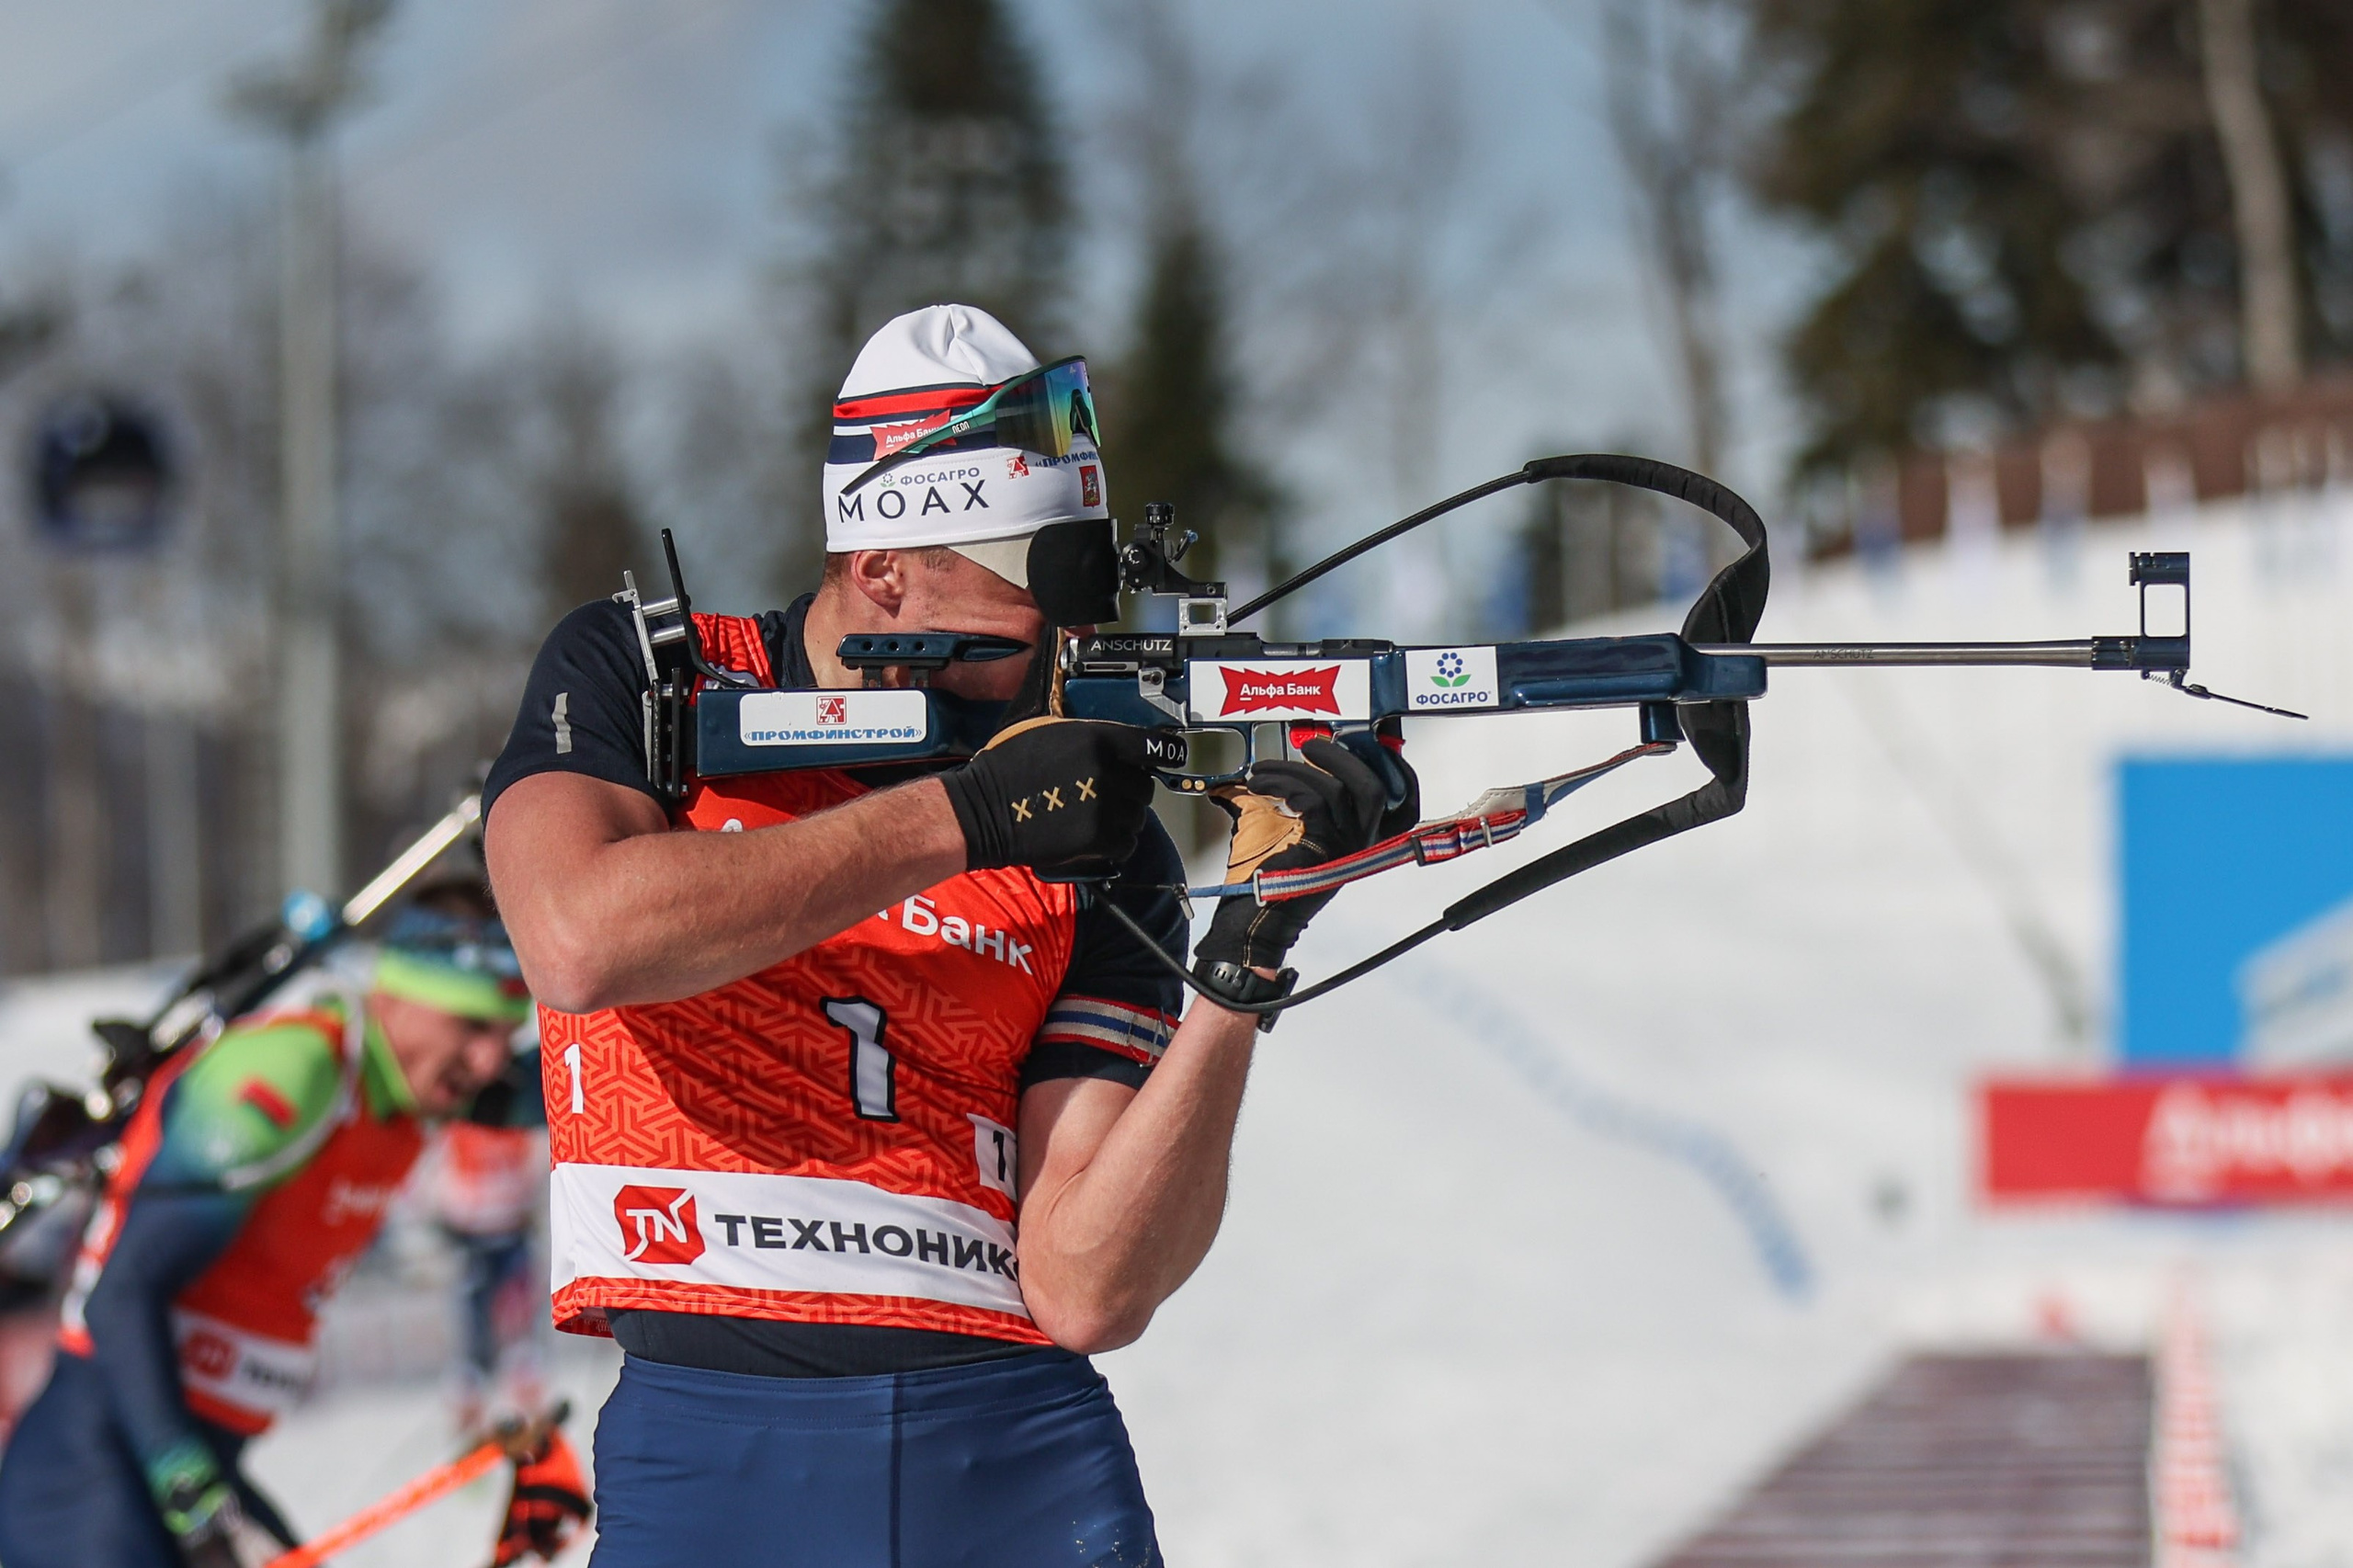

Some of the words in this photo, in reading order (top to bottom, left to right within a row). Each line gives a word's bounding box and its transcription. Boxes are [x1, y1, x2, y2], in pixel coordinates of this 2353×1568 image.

[886, 431, 915, 448] Альфа
[900, 467, 981, 486] ФОСАГРО
[837, 479, 990, 524] MOAX
[1240, 683, 1285, 701] Альфа
[1287, 682, 1322, 697] Банк
[1415, 690, 1489, 707] ФОСАГРО
[744, 725, 923, 742] «ПРОМФИНСТРОЙ»
[902, 893, 1034, 976] Банк
[563, 1043, 584, 1114] 1
[820, 994, 901, 1123] 1
[993, 1130, 1006, 1183] 1
[714, 1212, 1019, 1283] ТЕХНОНИК
